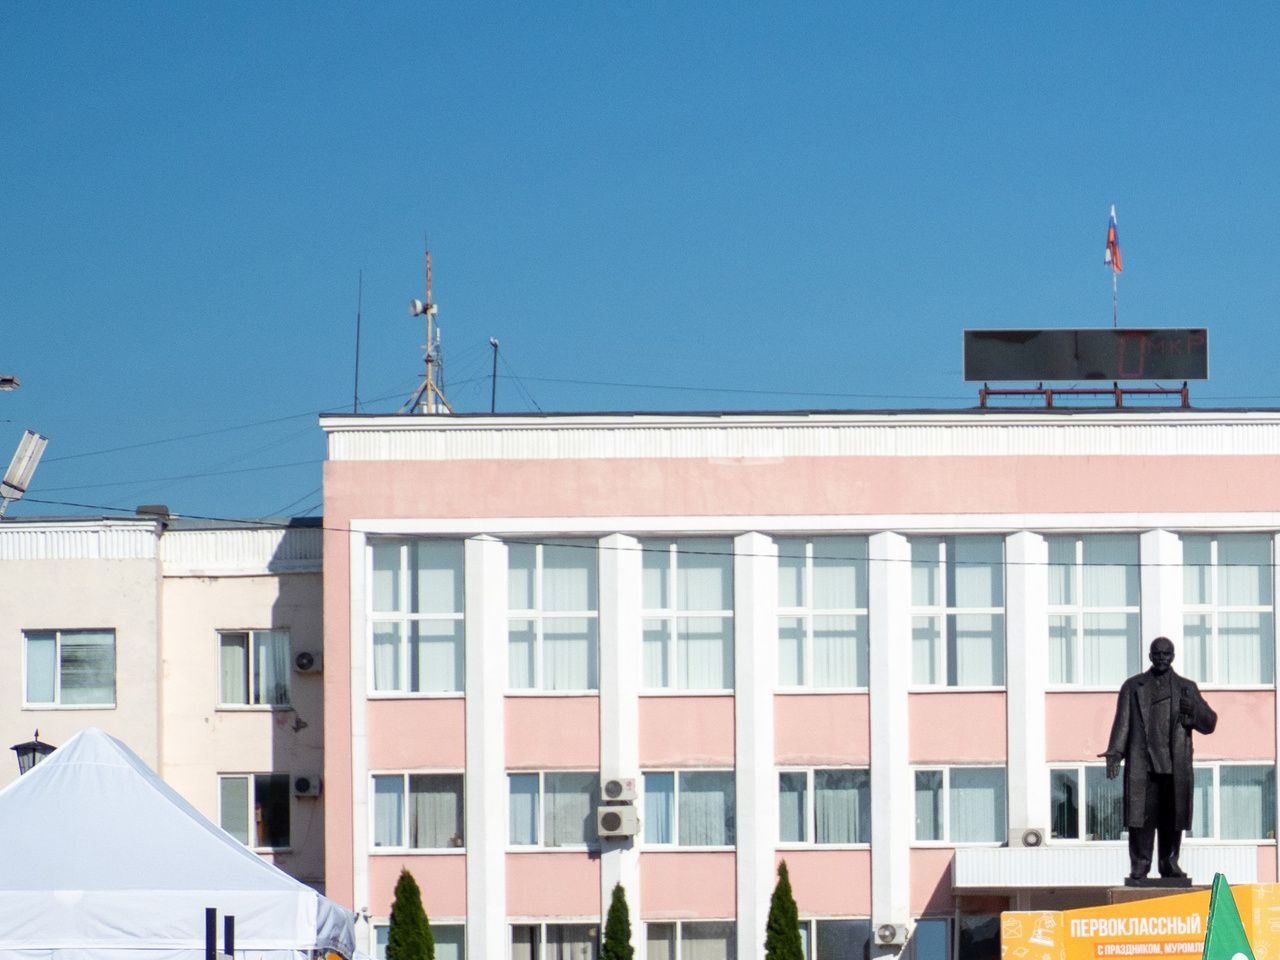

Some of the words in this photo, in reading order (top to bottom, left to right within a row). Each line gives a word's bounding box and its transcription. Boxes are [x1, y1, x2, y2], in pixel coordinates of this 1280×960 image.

[1070, 913, 1201, 937] ПЕРВОКЛАССНЫЙ
[1097, 944, 1104, 955] С
[1104, 943, 1163, 956] ПРАЗДНИКОМ,
